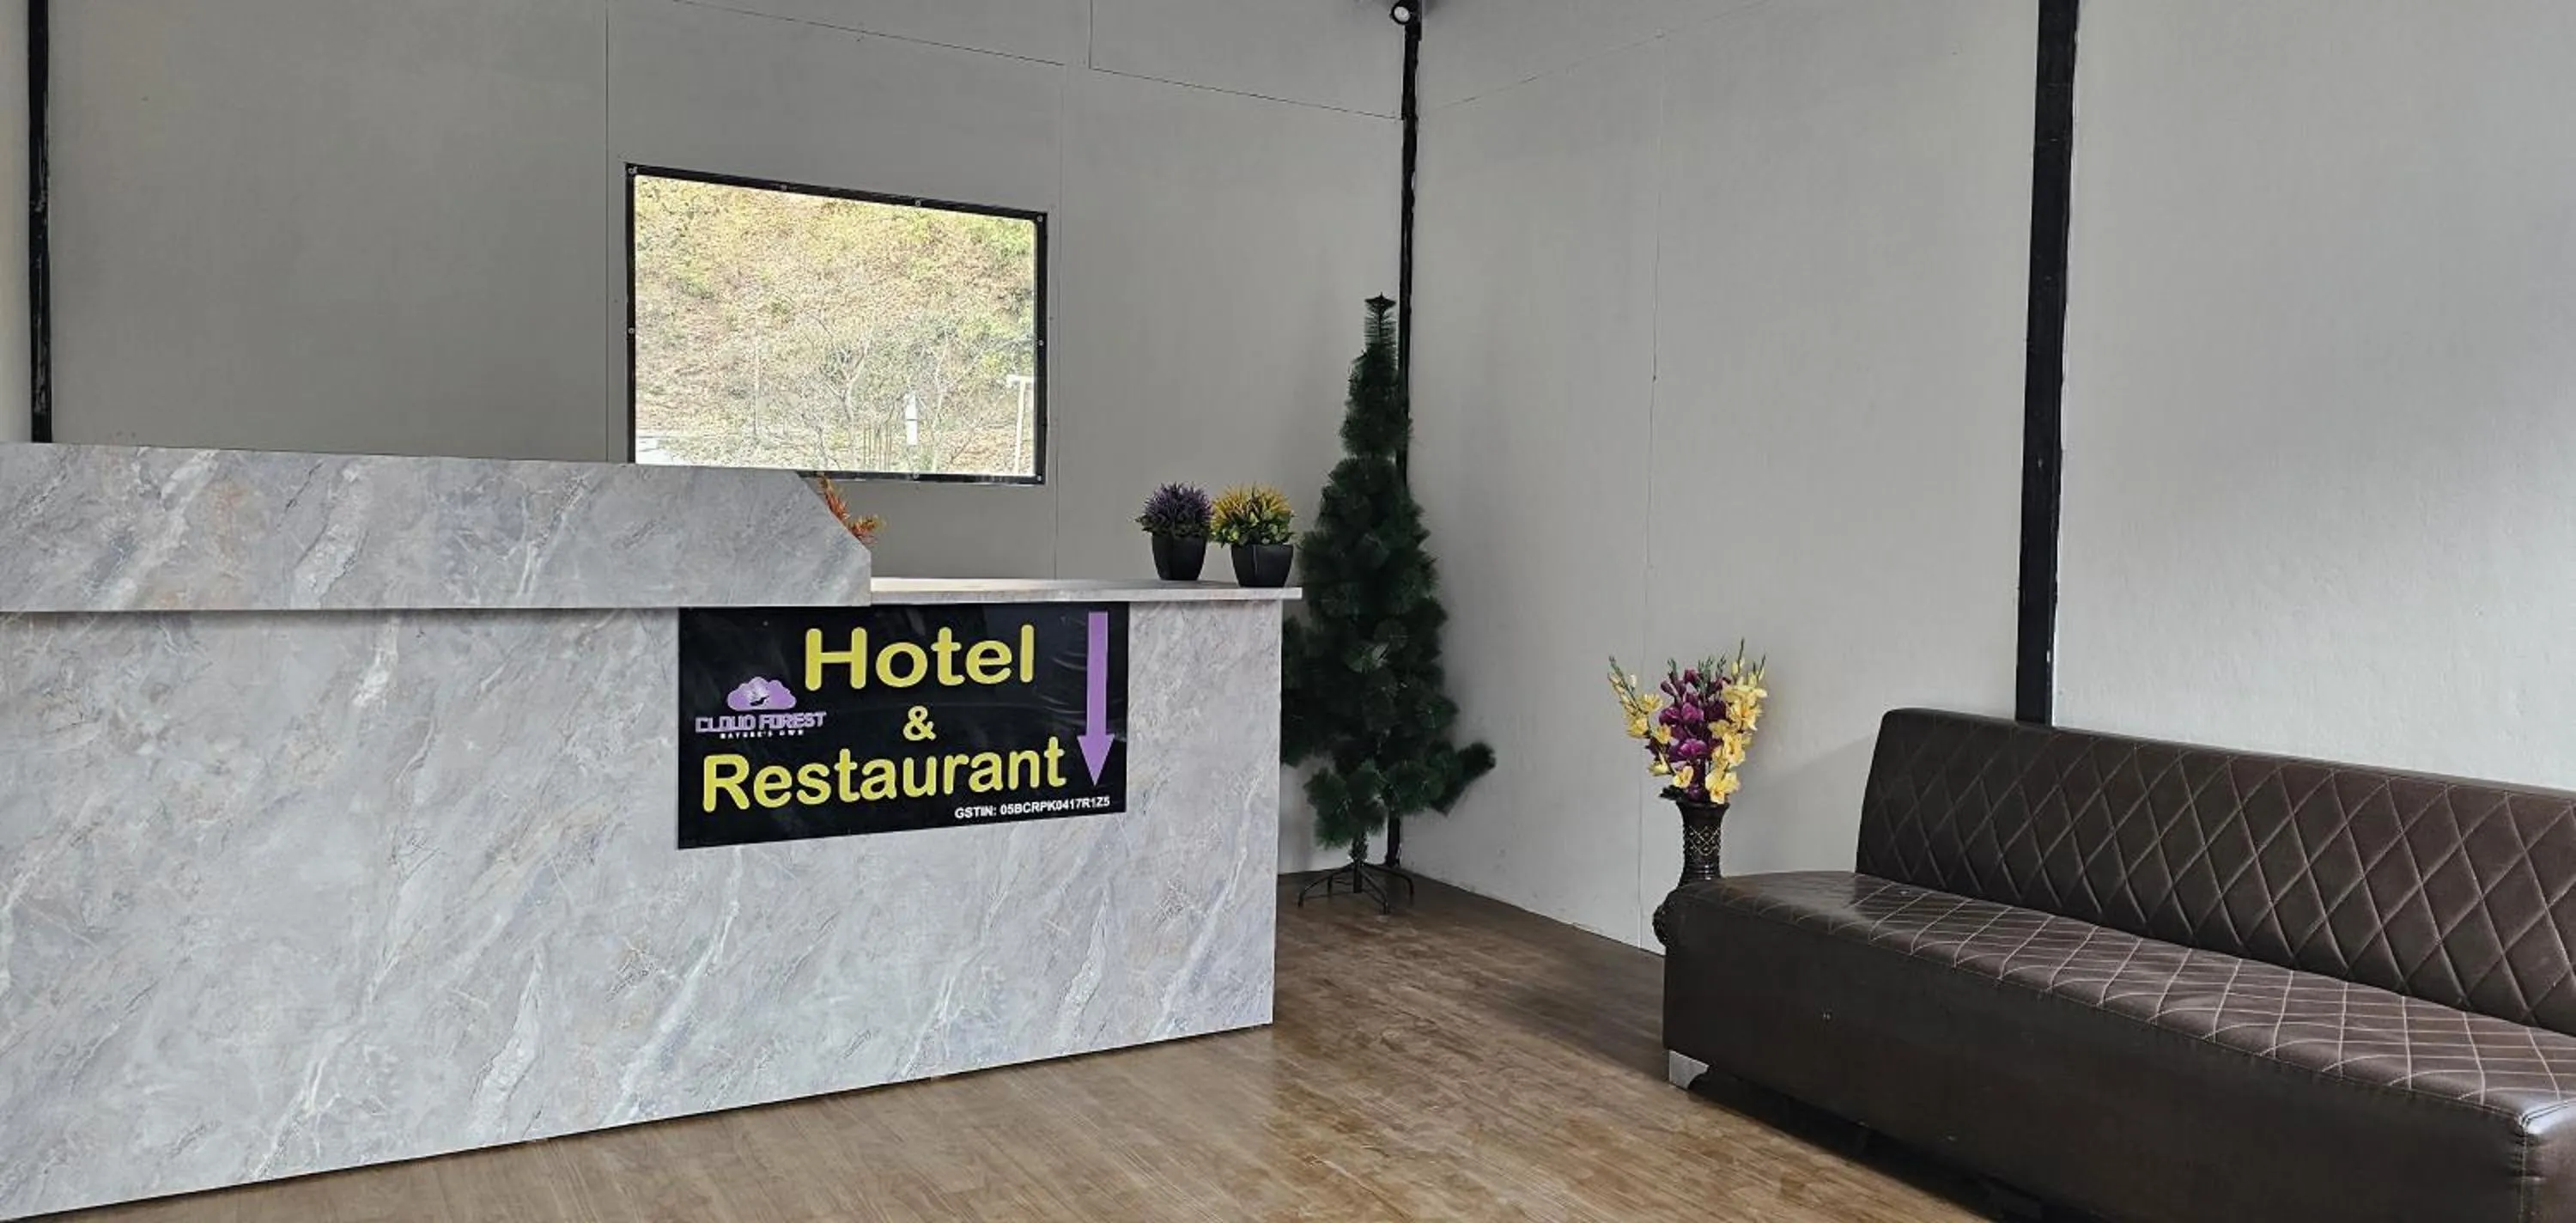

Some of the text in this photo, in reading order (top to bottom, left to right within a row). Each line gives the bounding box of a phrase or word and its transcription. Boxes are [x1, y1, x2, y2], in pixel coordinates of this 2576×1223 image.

[805, 624, 1035, 691] Hotel
[695, 711, 827, 733] CLOUD FOREST
[902, 705, 937, 742] &
[702, 736, 1067, 812] Restaurant
[954, 795, 1110, 818] GSTIN: 05BCRPK0417R1Z5
